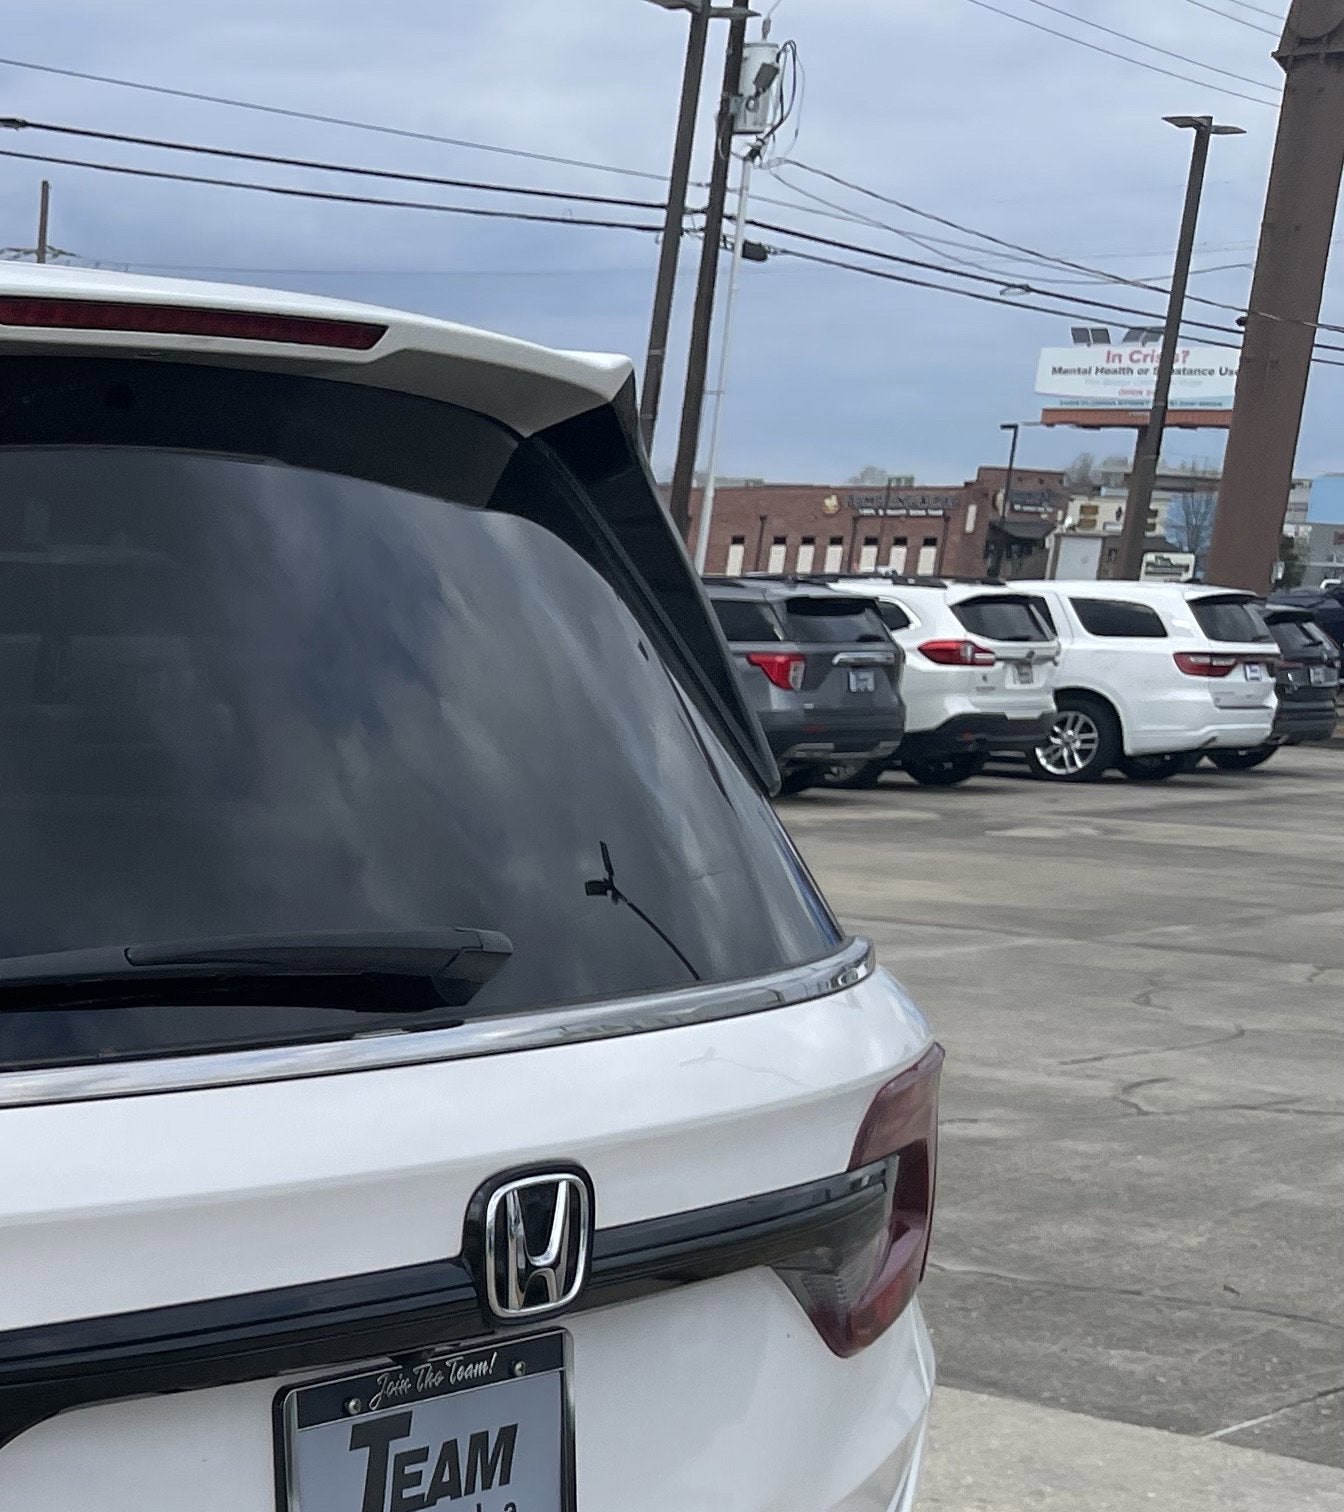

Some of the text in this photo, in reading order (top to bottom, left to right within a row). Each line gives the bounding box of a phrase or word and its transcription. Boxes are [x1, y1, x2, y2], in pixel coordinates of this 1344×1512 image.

[1106, 350, 1123, 365] In
[1051, 366, 1092, 376] Mental
[1095, 366, 1134, 376] Health
[1137, 367, 1150, 376] or
[369, 1351, 498, 1411] Join The Team!
